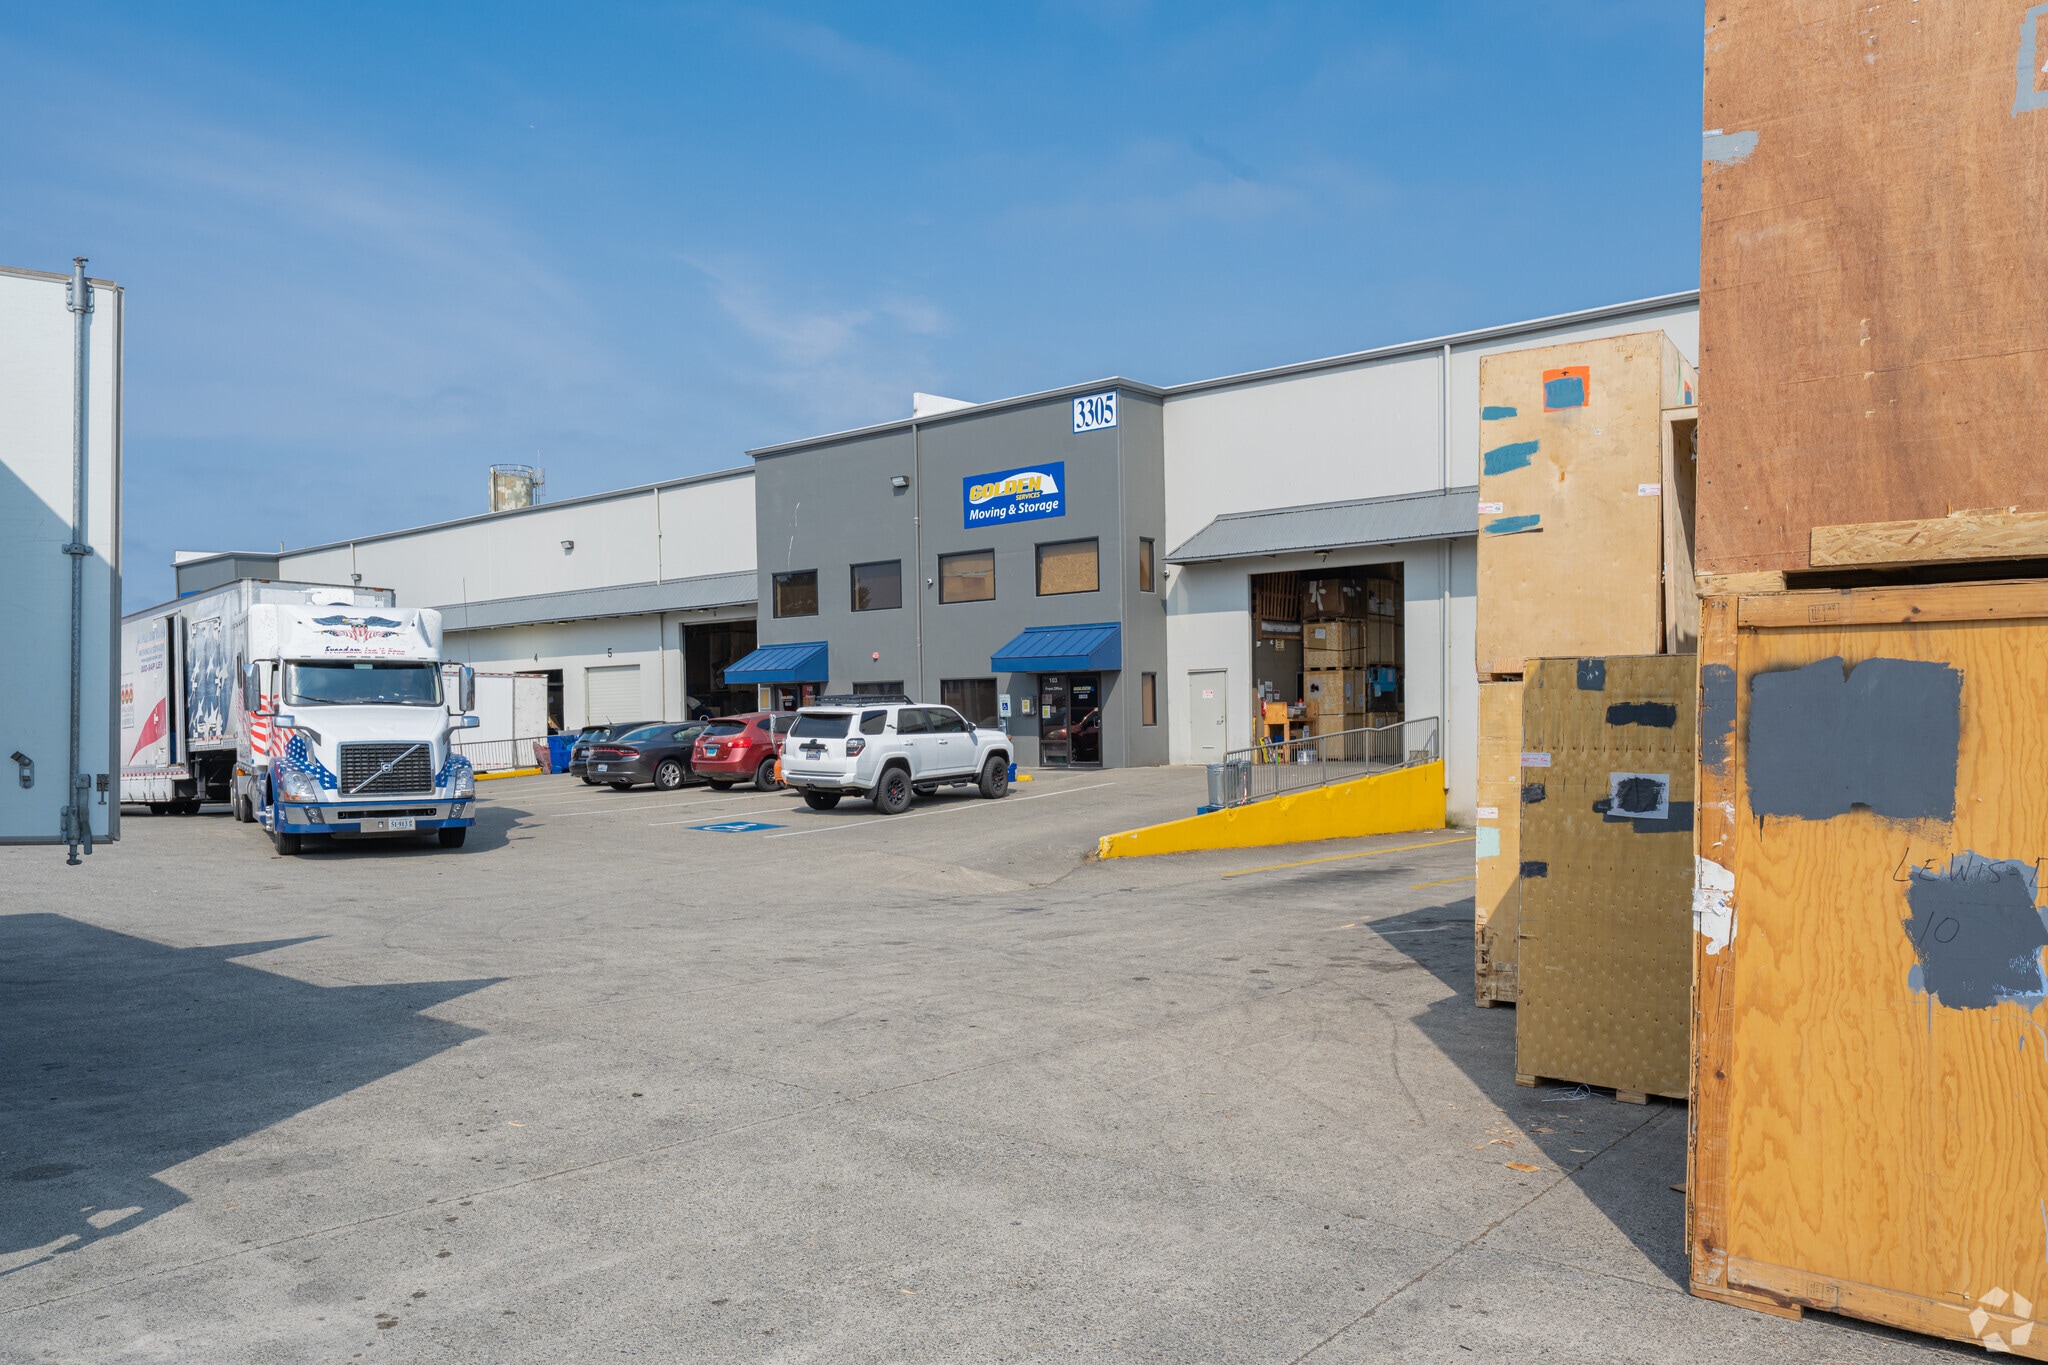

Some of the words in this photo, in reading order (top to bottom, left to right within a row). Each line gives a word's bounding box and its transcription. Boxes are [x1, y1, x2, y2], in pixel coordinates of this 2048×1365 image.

[1075, 394, 1114, 429] 3305
[968, 475, 1042, 501] GOLDEN
[1015, 491, 1041, 501] SERVICES
[969, 506, 1007, 521] Moving
[1008, 503, 1017, 515] &
[1018, 500, 1059, 514] Storage
[533, 652, 539, 663] 4
[607, 647, 613, 658] 5
[1918, 911, 1960, 945] 10
